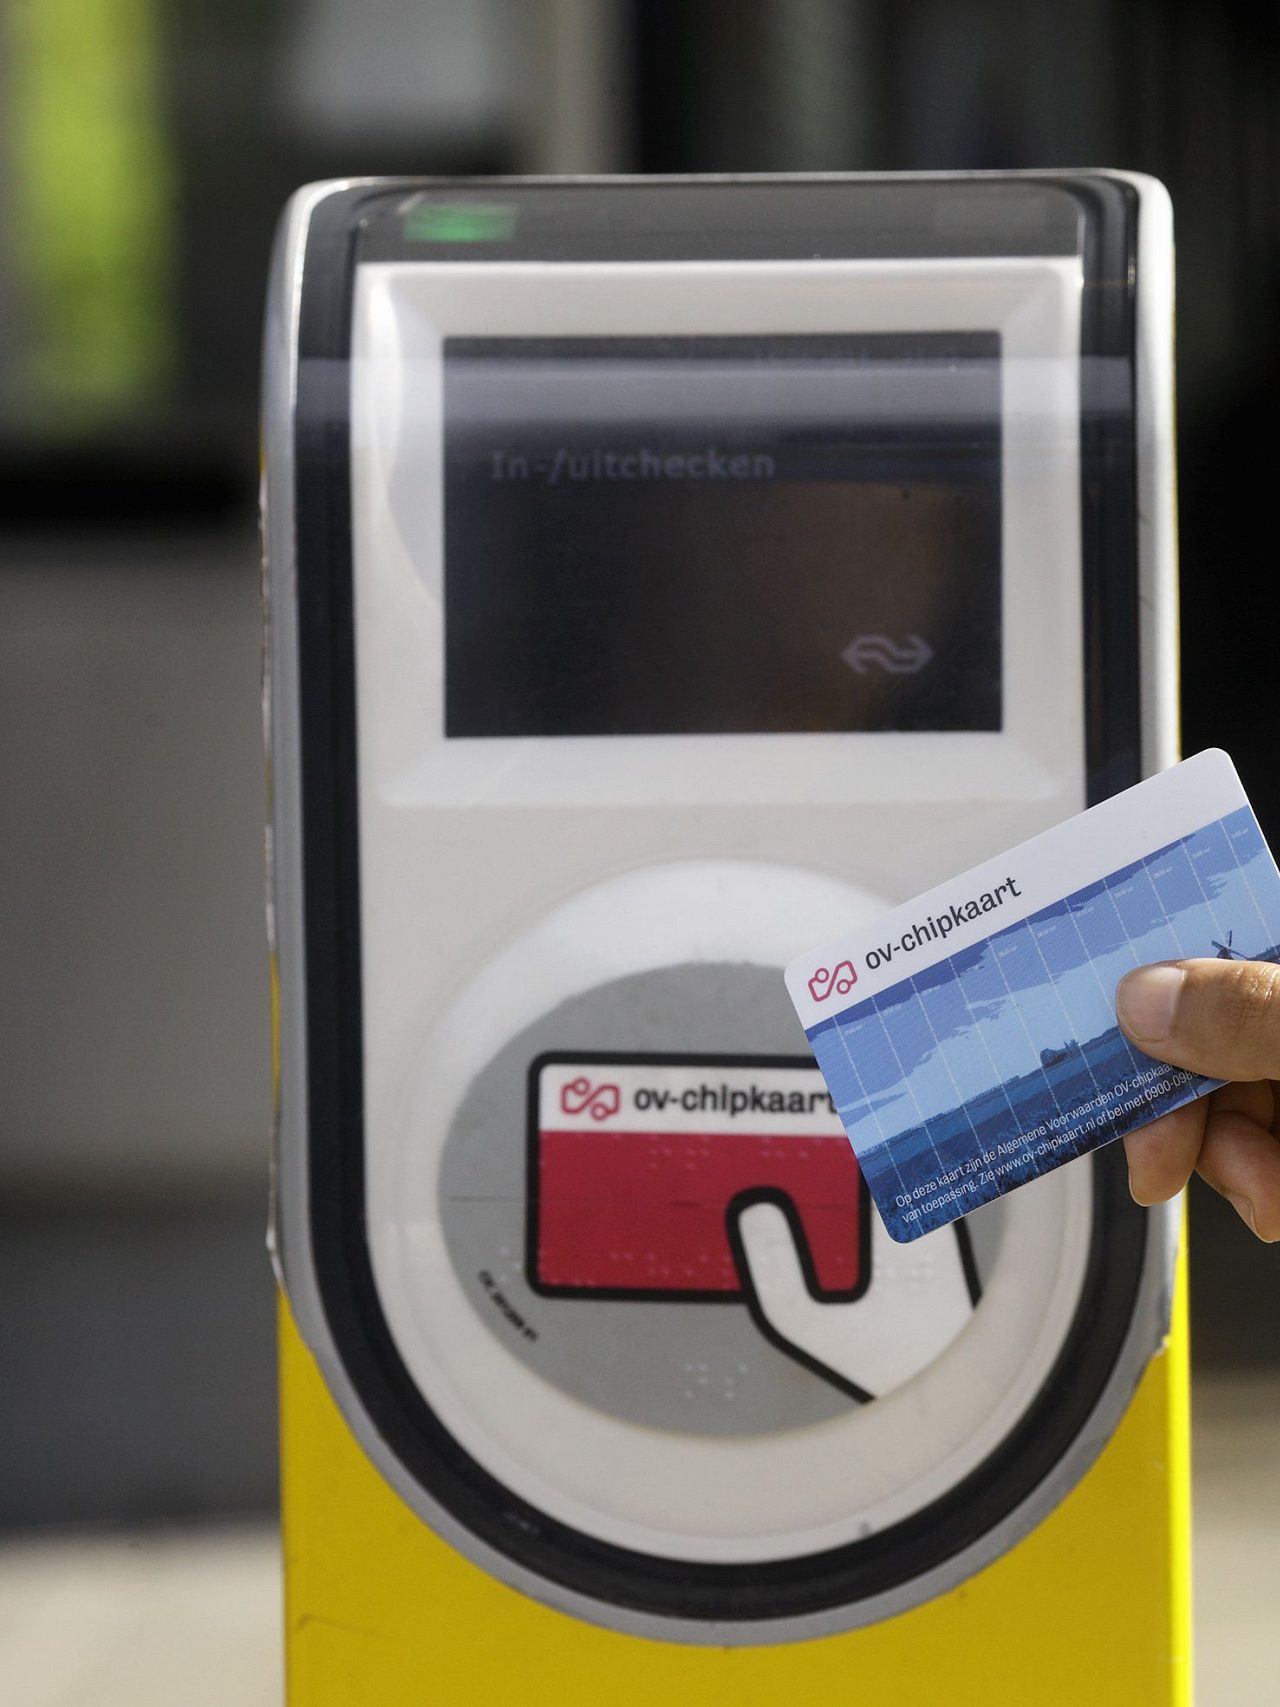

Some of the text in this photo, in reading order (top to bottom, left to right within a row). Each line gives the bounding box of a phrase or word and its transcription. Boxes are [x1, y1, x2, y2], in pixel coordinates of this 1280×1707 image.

[491, 449, 774, 482] In-/uitchecken
[865, 877, 1022, 970] ov-chipkaart
[896, 1191, 912, 1208] Op
[912, 1181, 937, 1200] deze
[937, 1166, 965, 1186] kaart
[964, 1158, 983, 1175] zijn
[982, 1151, 997, 1165] de
[997, 1126, 1047, 1159] Algemene
[1045, 1091, 1115, 1130] Voorwaarden
[902, 1208, 922, 1223] van
[922, 1178, 978, 1213] toepassing.
[977, 1168, 996, 1186] Zie
[993, 1117, 1096, 1176] www.ov-chipkaart.nl
[1096, 1111, 1108, 1126] of
[1107, 1103, 1125, 1120] bel
[1123, 1094, 1146, 1112] met
